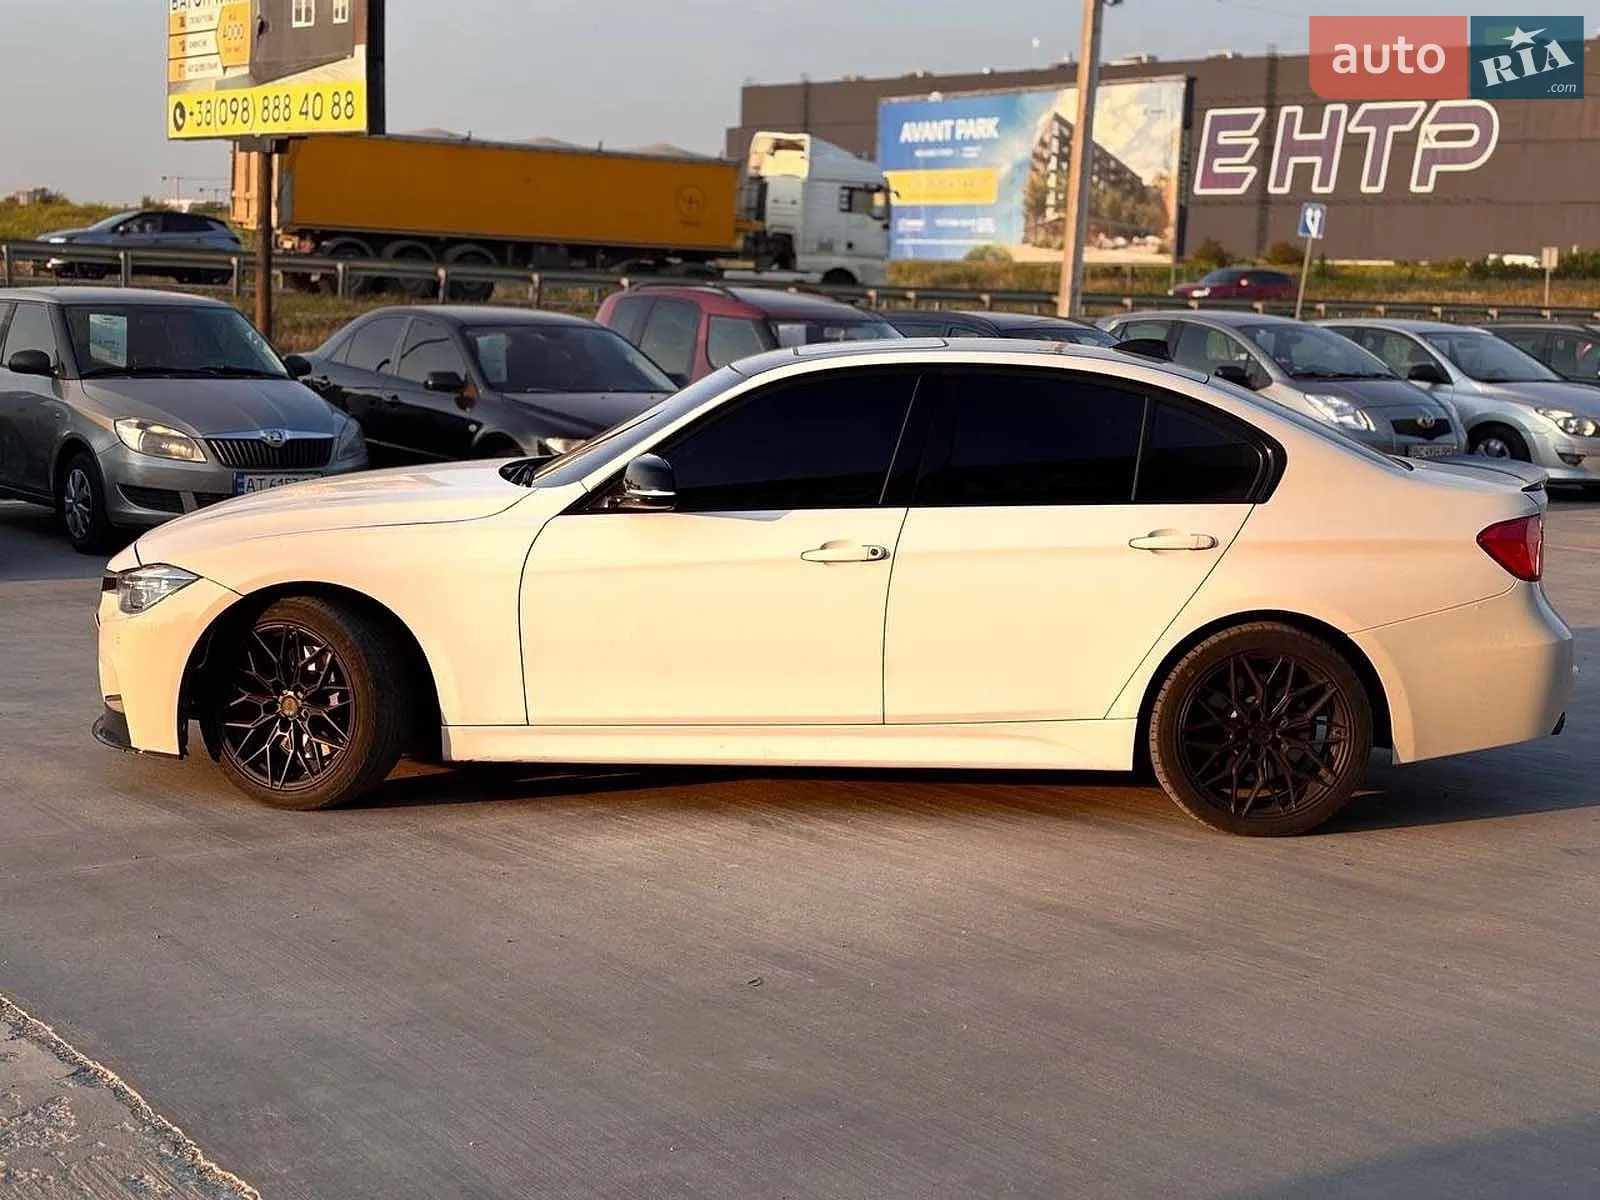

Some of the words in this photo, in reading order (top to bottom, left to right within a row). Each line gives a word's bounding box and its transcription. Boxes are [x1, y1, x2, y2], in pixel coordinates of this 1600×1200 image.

[261, 94, 291, 123] 888
[299, 92, 323, 121] 40
[331, 90, 354, 120] 88
[899, 119, 954, 144] AVANT
[955, 117, 1000, 140] PARK
